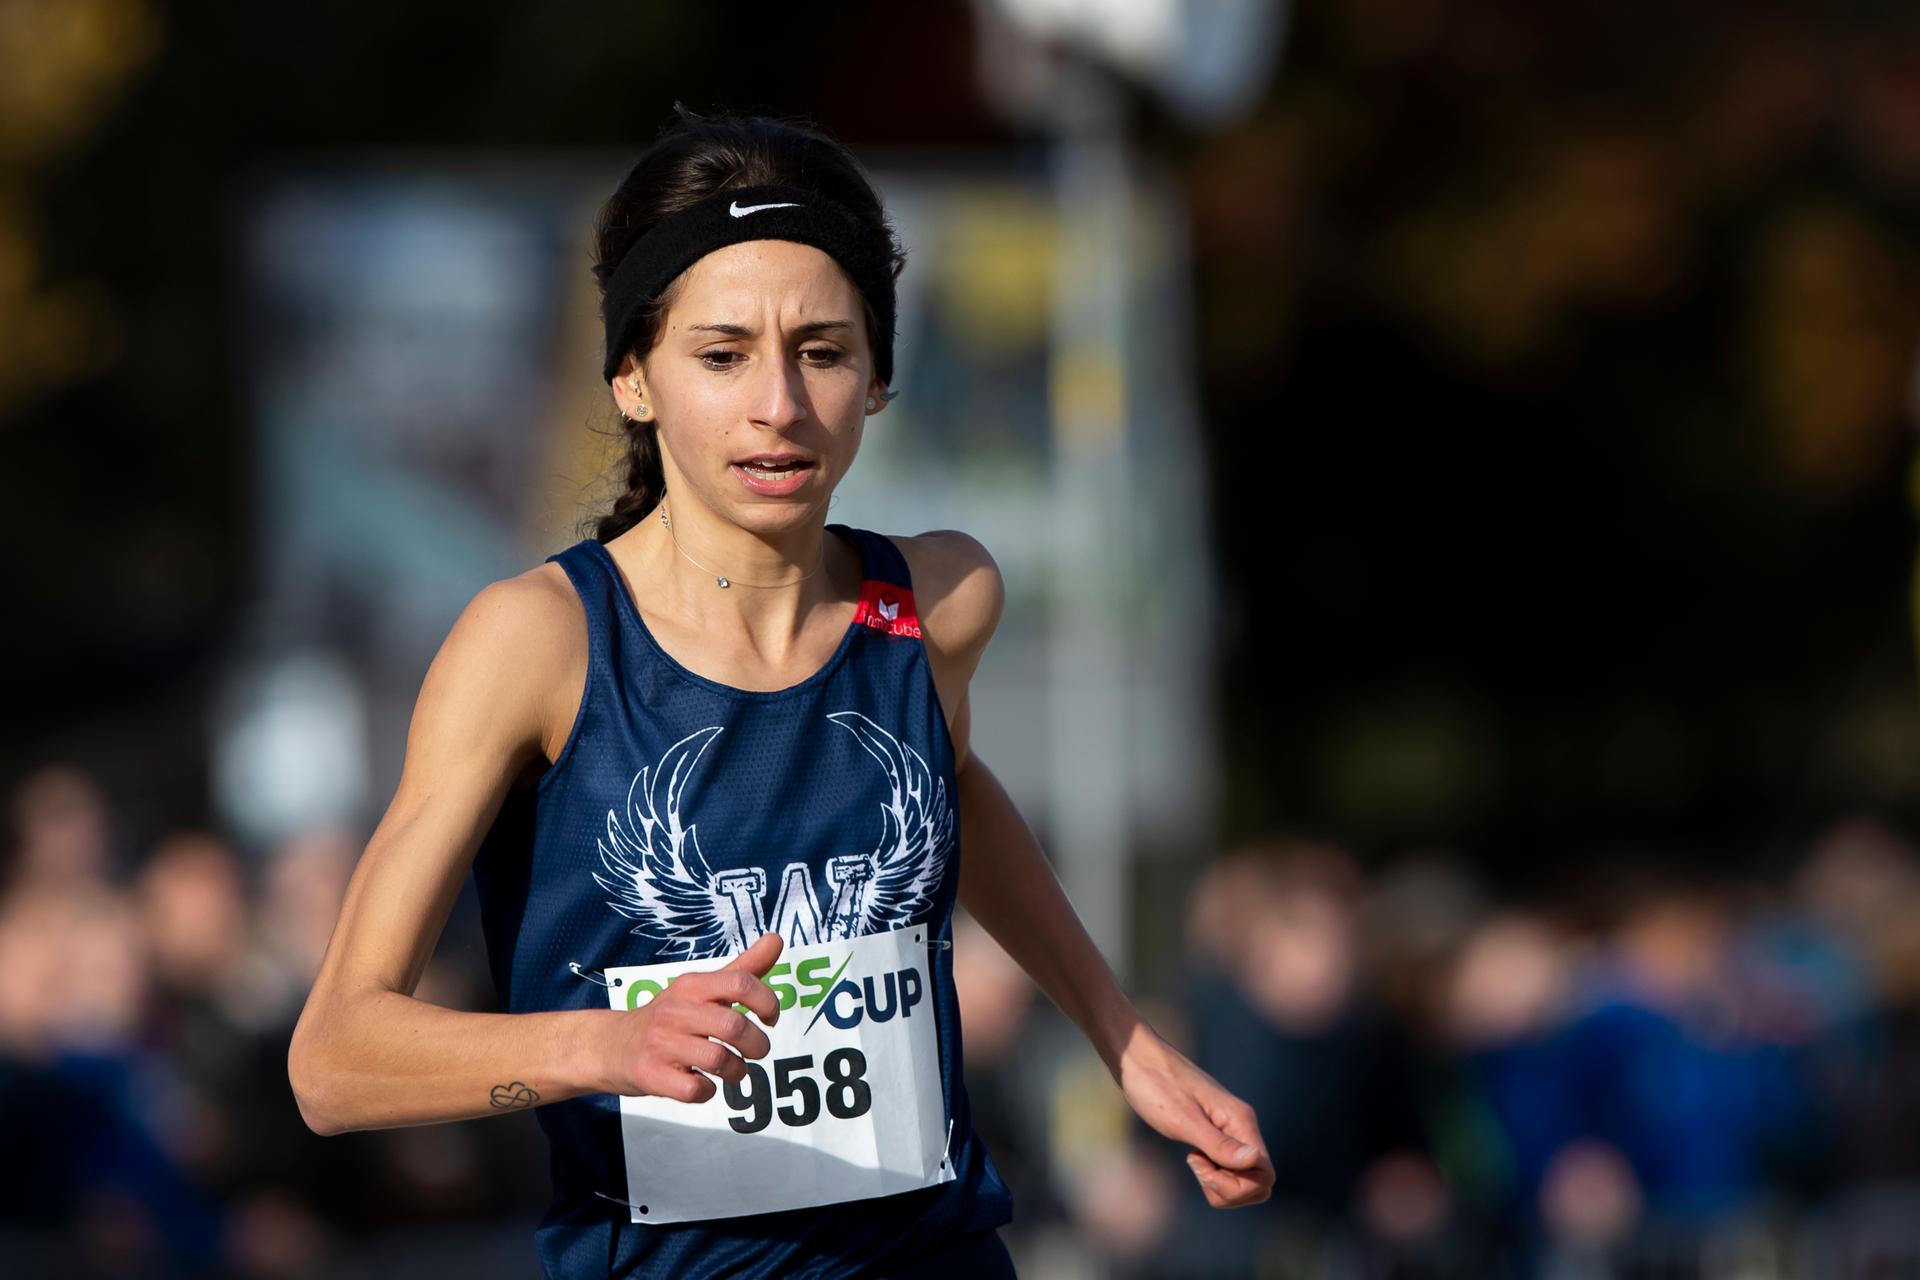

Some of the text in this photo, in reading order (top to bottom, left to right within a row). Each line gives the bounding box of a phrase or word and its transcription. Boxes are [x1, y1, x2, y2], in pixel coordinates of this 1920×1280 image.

[626, 956, 923, 1031] CSS CUP
[722, 1046, 872, 1135] 958
